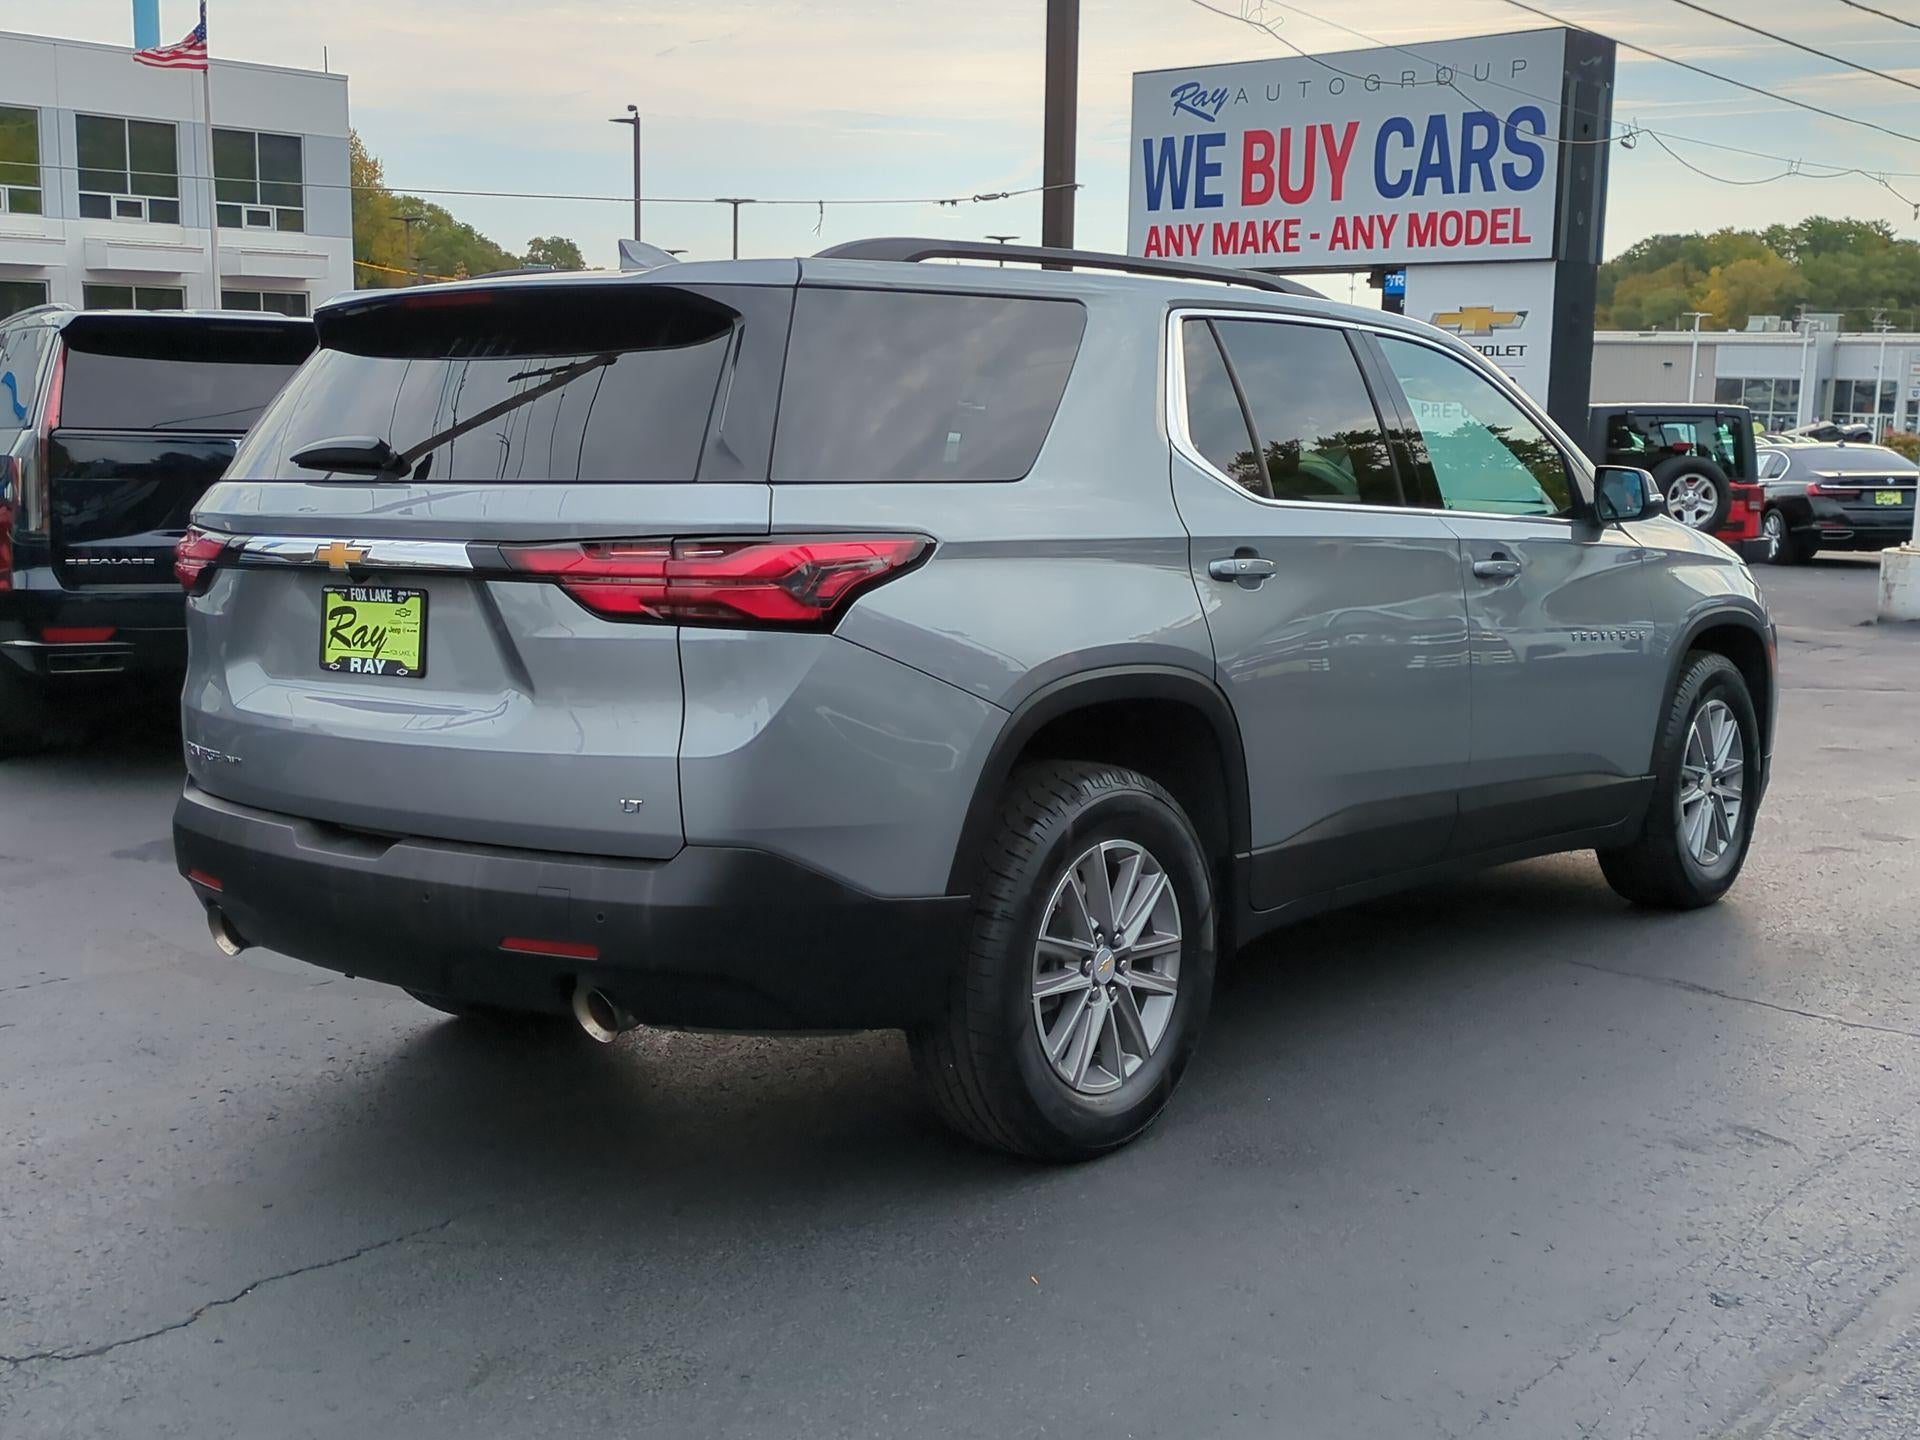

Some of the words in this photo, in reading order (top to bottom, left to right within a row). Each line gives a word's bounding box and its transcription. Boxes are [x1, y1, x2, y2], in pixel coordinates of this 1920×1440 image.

[1170, 81, 1229, 122] Ray
[1233, 59, 1527, 105] AUTOGROUP
[1142, 132, 1226, 212] WE
[1241, 121, 1360, 206] BUY
[1374, 105, 1547, 199] CARS
[1144, 223, 1203, 258] ANY
[1212, 218, 1301, 255] MAKE
[1328, 213, 1399, 251] ANY
[1407, 207, 1531, 248] MODEL
[350, 588, 368, 602] FOX
[369, 589, 393, 602] LAKE
[328, 606, 388, 658] Ray
[350, 658, 386, 674] RAY
[620, 799, 643, 813] LT
